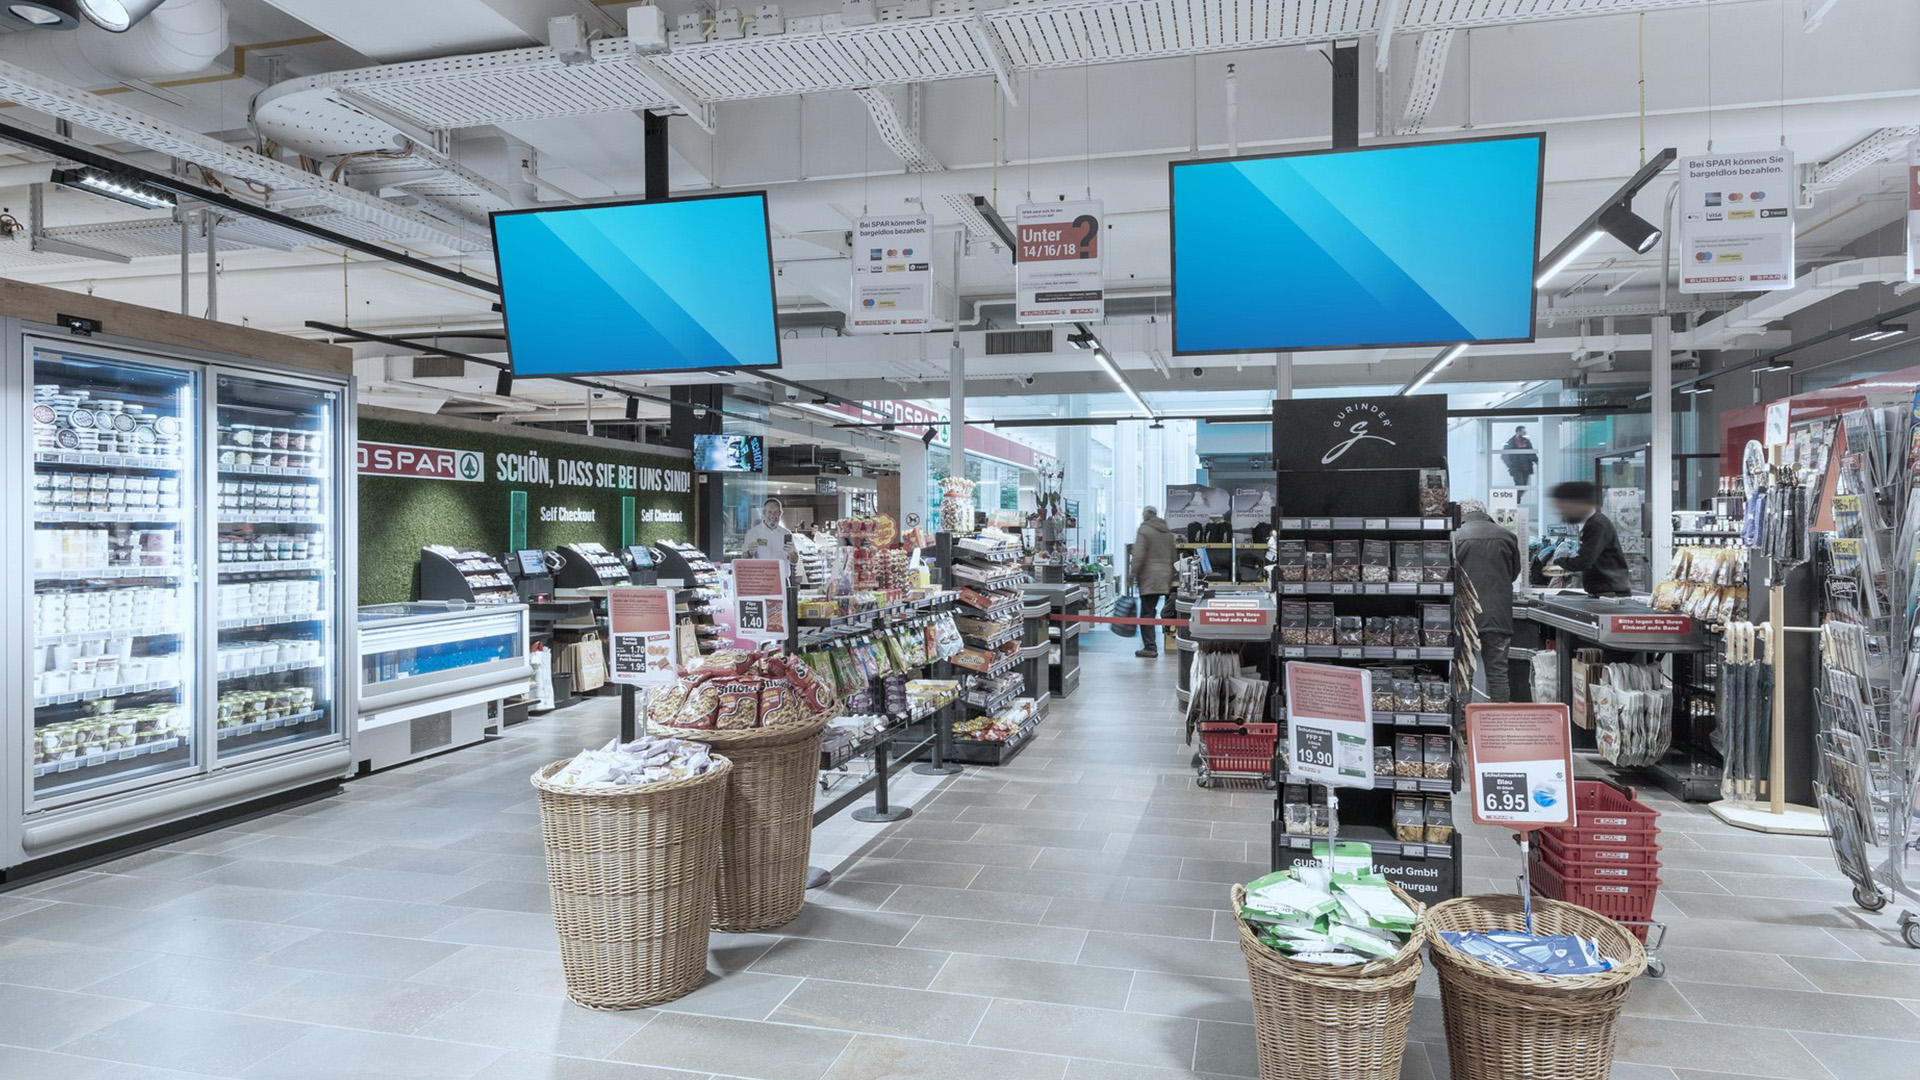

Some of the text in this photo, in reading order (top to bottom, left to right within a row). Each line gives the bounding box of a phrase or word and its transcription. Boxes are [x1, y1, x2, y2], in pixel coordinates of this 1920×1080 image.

[1690, 156, 1784, 168] Bei SPAR können Sie
[1690, 166, 1783, 178] bargeldlos bezahlen.
[872, 220, 890, 228] SPAR
[860, 227, 926, 237] bargeldlos bezahlen.
[1022, 229, 1062, 242] Unter
[1023, 244, 1076, 257] 14/16/18
[1333, 403, 1390, 428] GURINDER
[496, 450, 691, 494] SCHÖN, DASS SIE BEI UNS SIND!
[540, 506, 596, 522] Self Checkout
[641, 508, 682, 523] Self Checkout
[742, 616, 762, 627] 1.40
[630, 663, 645, 671] 1.95
[1297, 726, 1331, 736] Schutzmasken
[1298, 748, 1332, 766] 19.90
[1486, 794, 1525, 810] 6.95
[1380, 865, 1403, 874] food
[1406, 867, 1438, 877] GmbH
[1395, 880, 1438, 892] Thurgau
